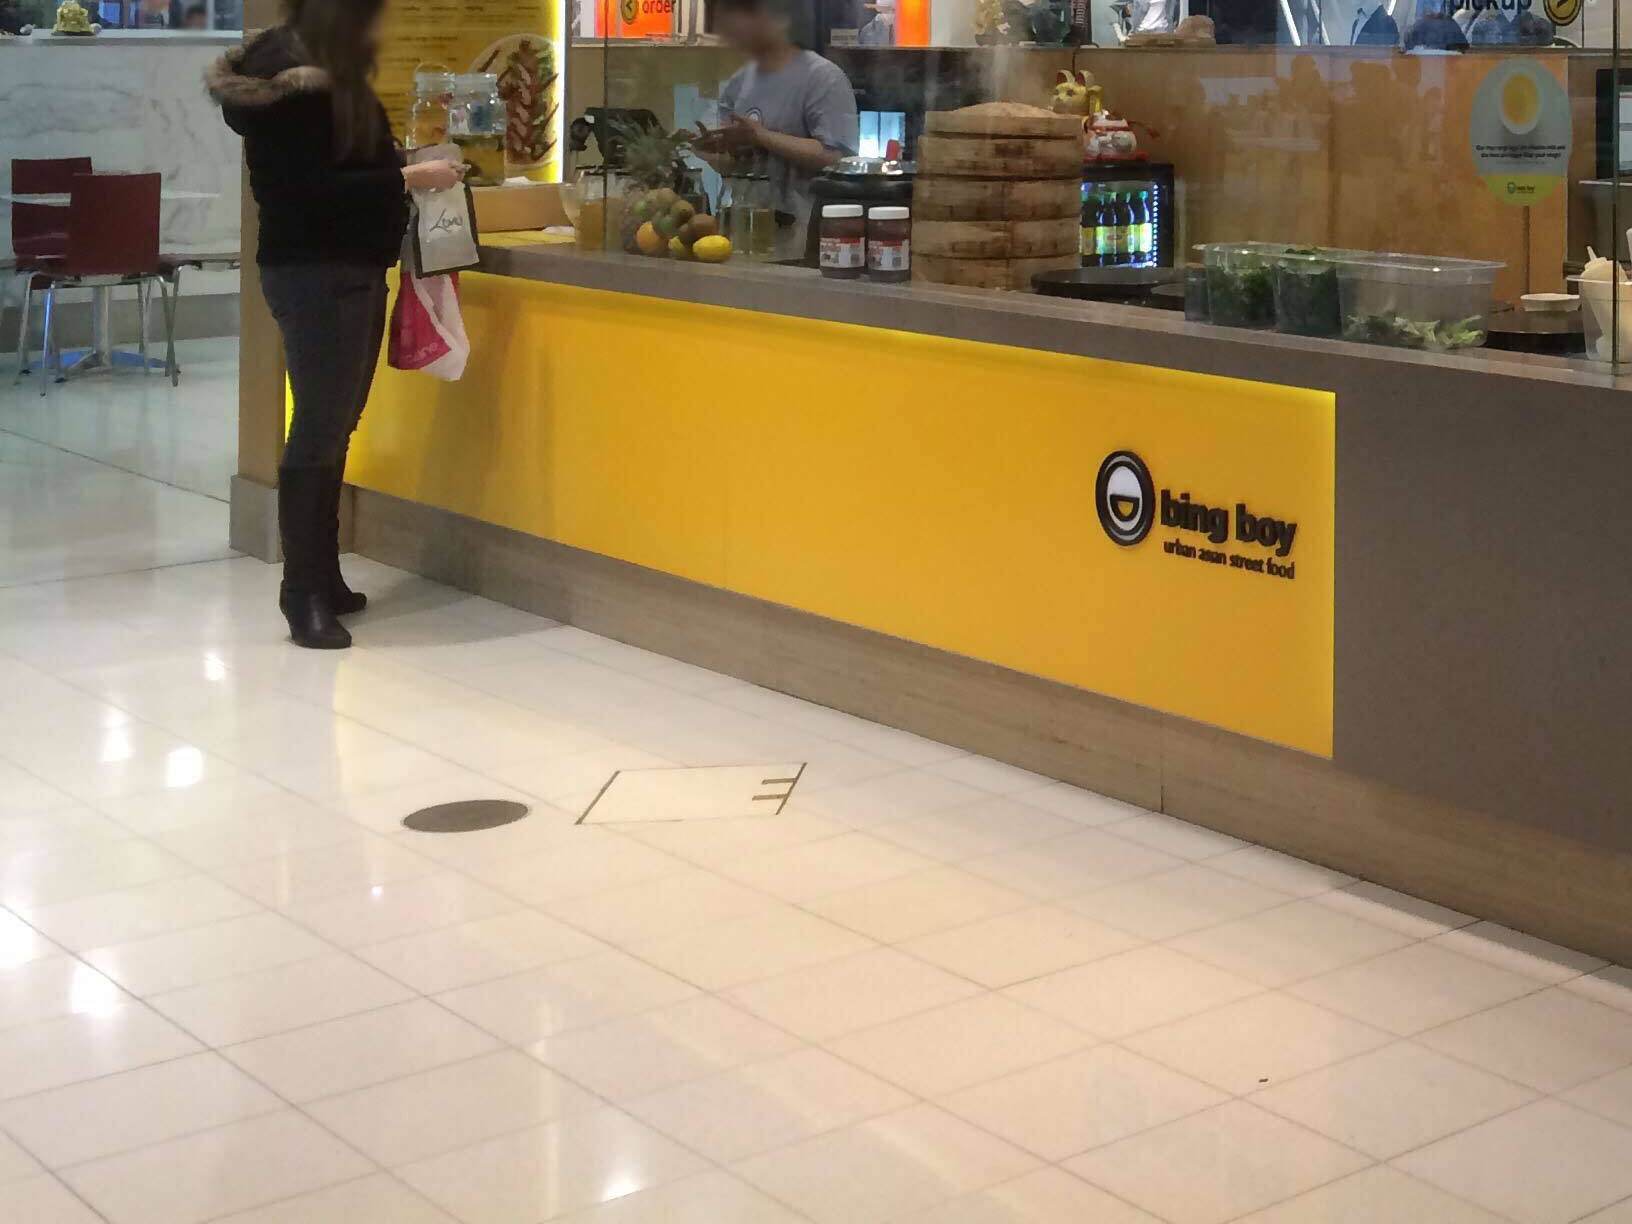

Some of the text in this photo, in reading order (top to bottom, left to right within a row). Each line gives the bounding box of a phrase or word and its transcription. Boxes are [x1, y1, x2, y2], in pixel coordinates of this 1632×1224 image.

[1160, 488, 1298, 557] bing boy
[1163, 538, 1197, 559] urban
[1229, 554, 1265, 574] street
[1266, 556, 1296, 580] food
